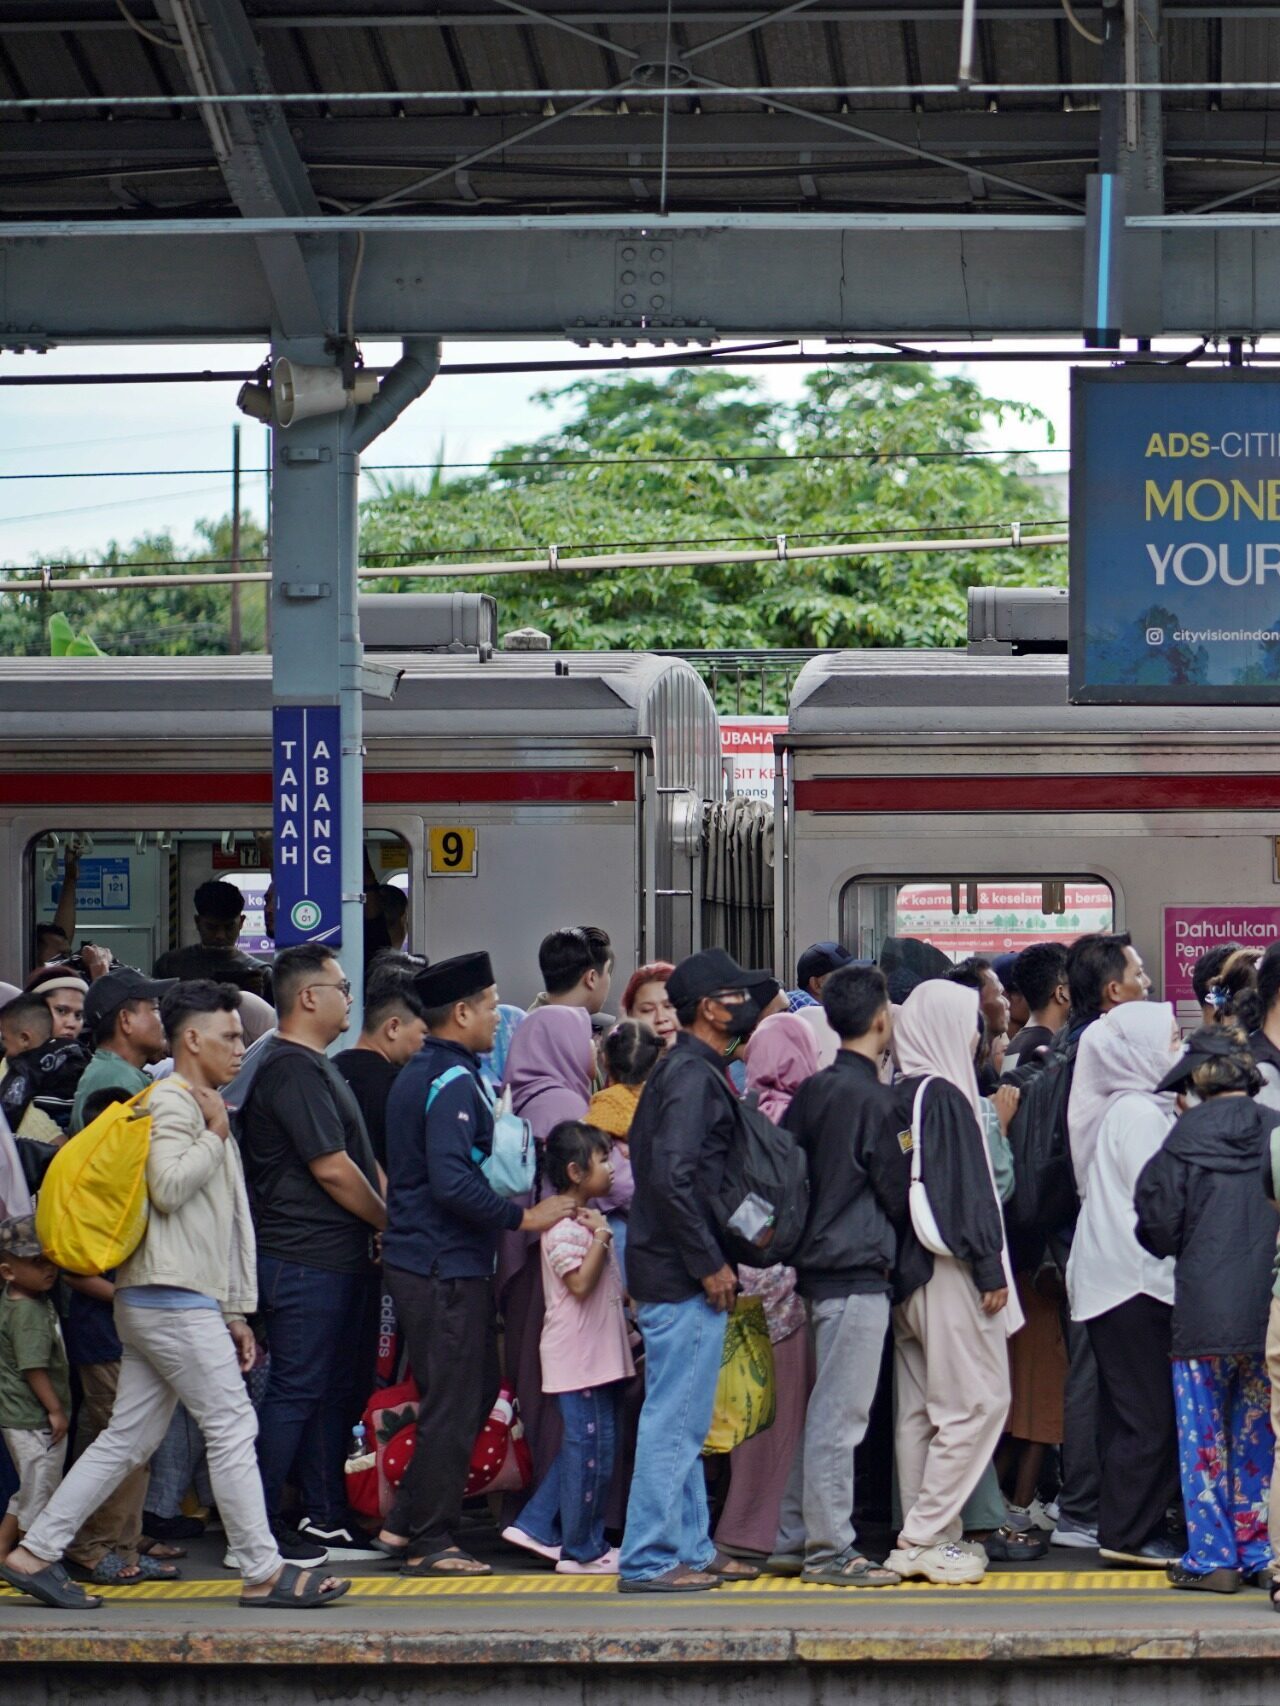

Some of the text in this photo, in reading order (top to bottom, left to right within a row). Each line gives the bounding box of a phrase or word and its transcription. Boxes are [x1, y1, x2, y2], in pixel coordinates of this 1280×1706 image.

[280, 740, 298, 865] TANAH
[313, 740, 332, 865] ABANG
[442, 832, 464, 867] 9
[1176, 920, 1278, 938] Dahulukan
[379, 1294, 396, 1357] adidas
